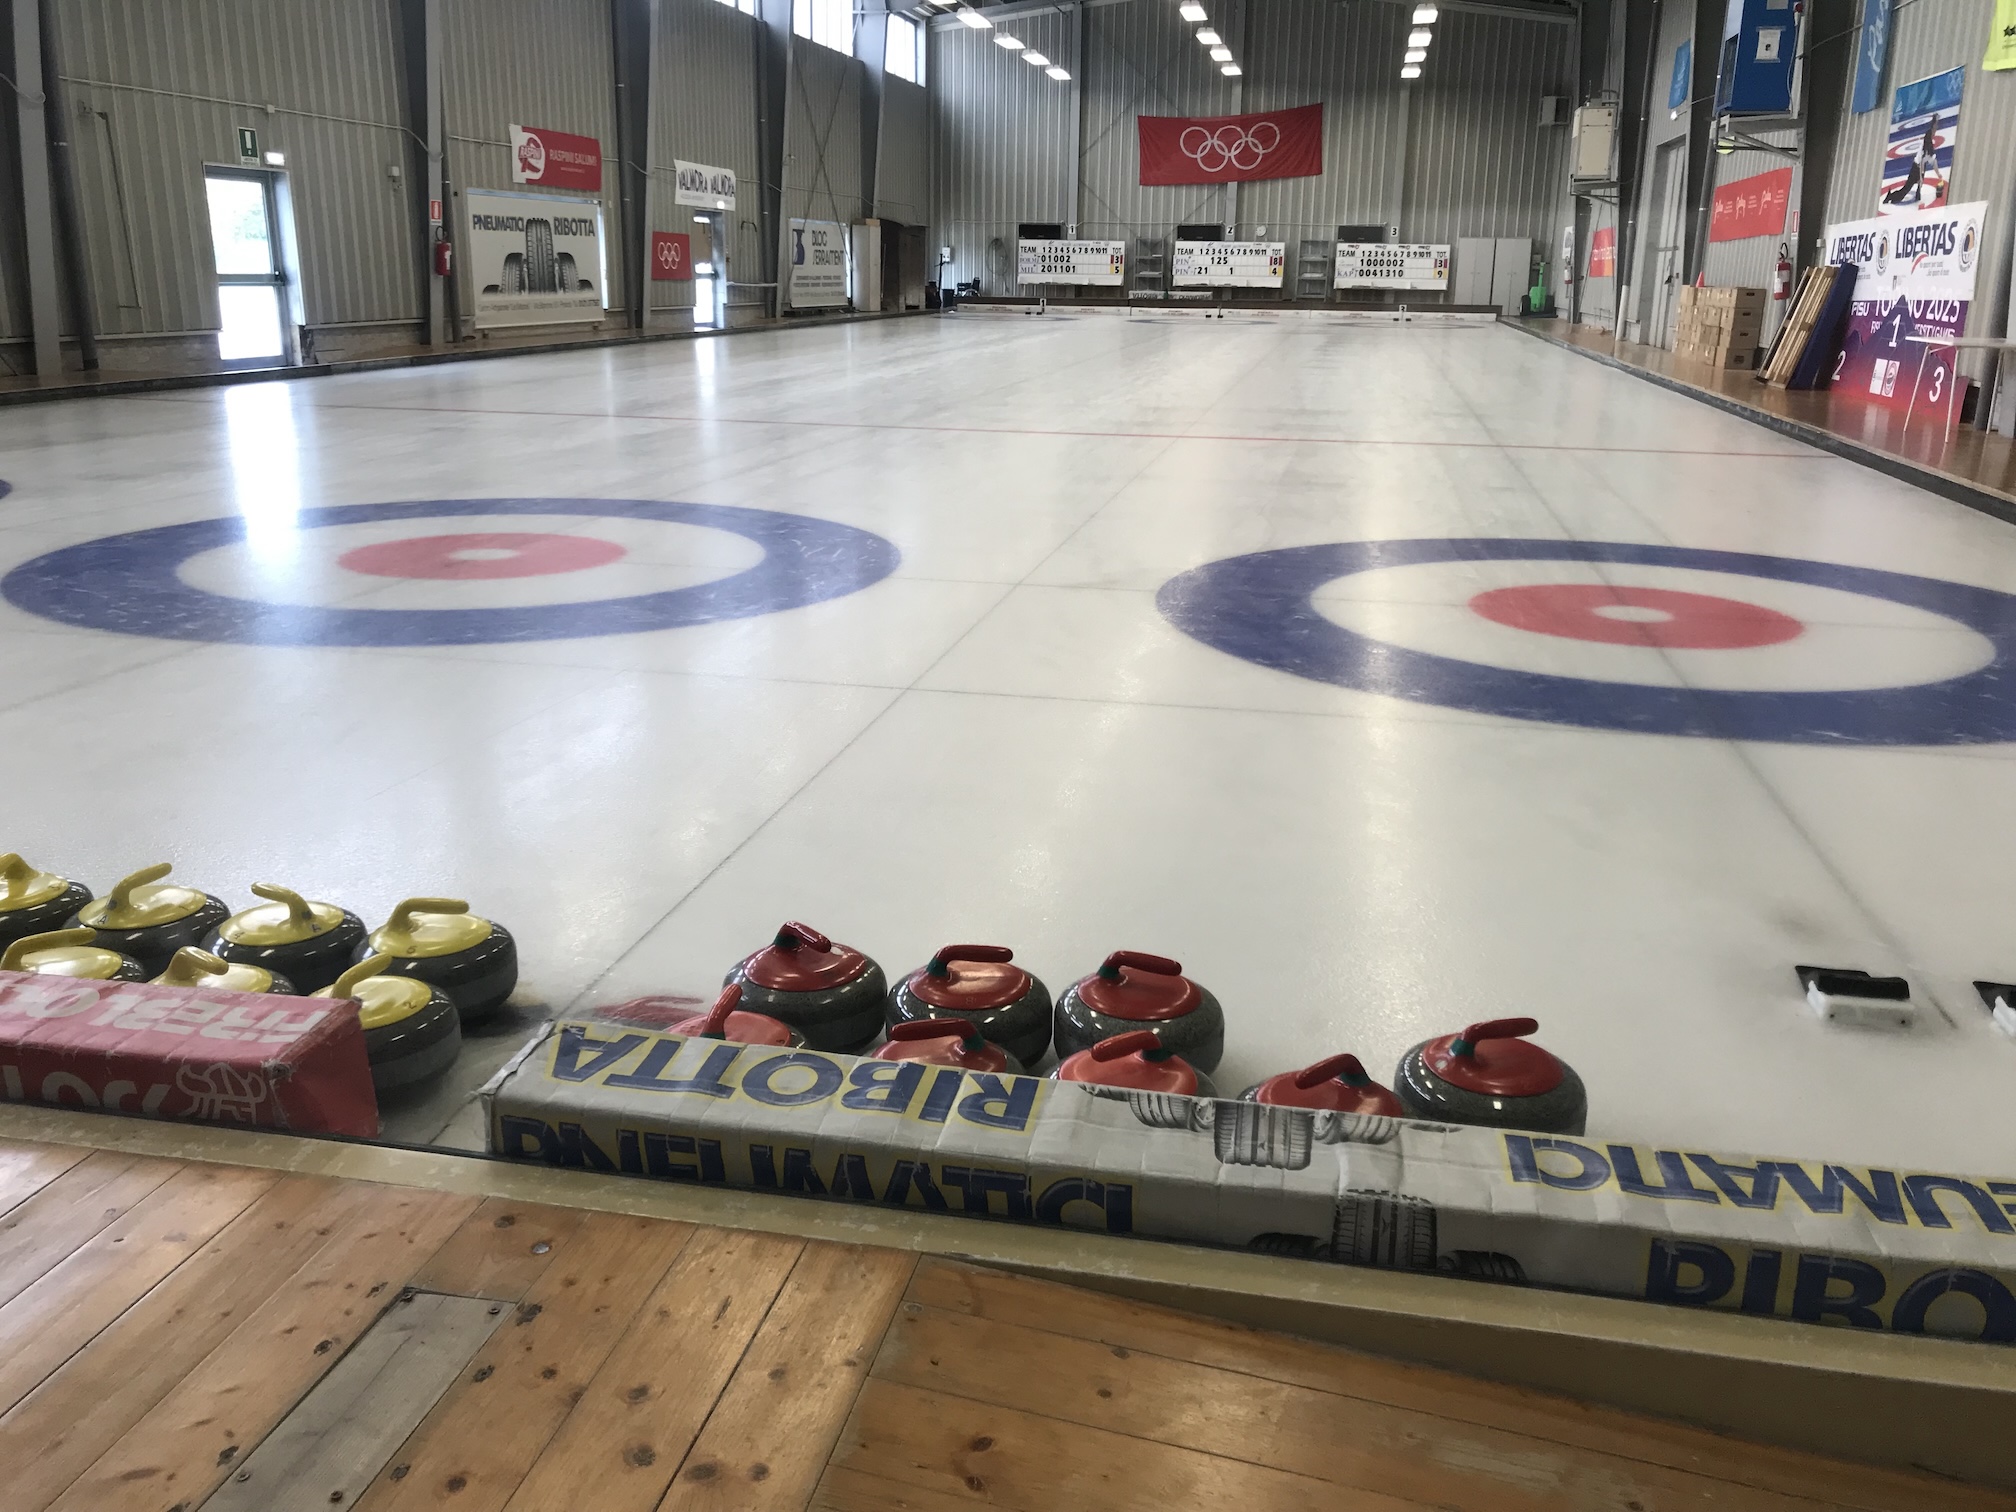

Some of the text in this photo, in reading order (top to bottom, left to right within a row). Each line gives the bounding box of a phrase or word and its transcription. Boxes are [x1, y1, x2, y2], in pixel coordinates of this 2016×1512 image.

[472, 214, 596, 237] PNEUMATICI RIBOTTA
[1830, 221, 1958, 265] LIBERTAS LIBERTAS
[1888, 314, 1901, 348] 1
[1832, 350, 1846, 380] 2
[1928, 366, 1945, 402] 3
[556, 1024, 1044, 1131] RIBOTTA
